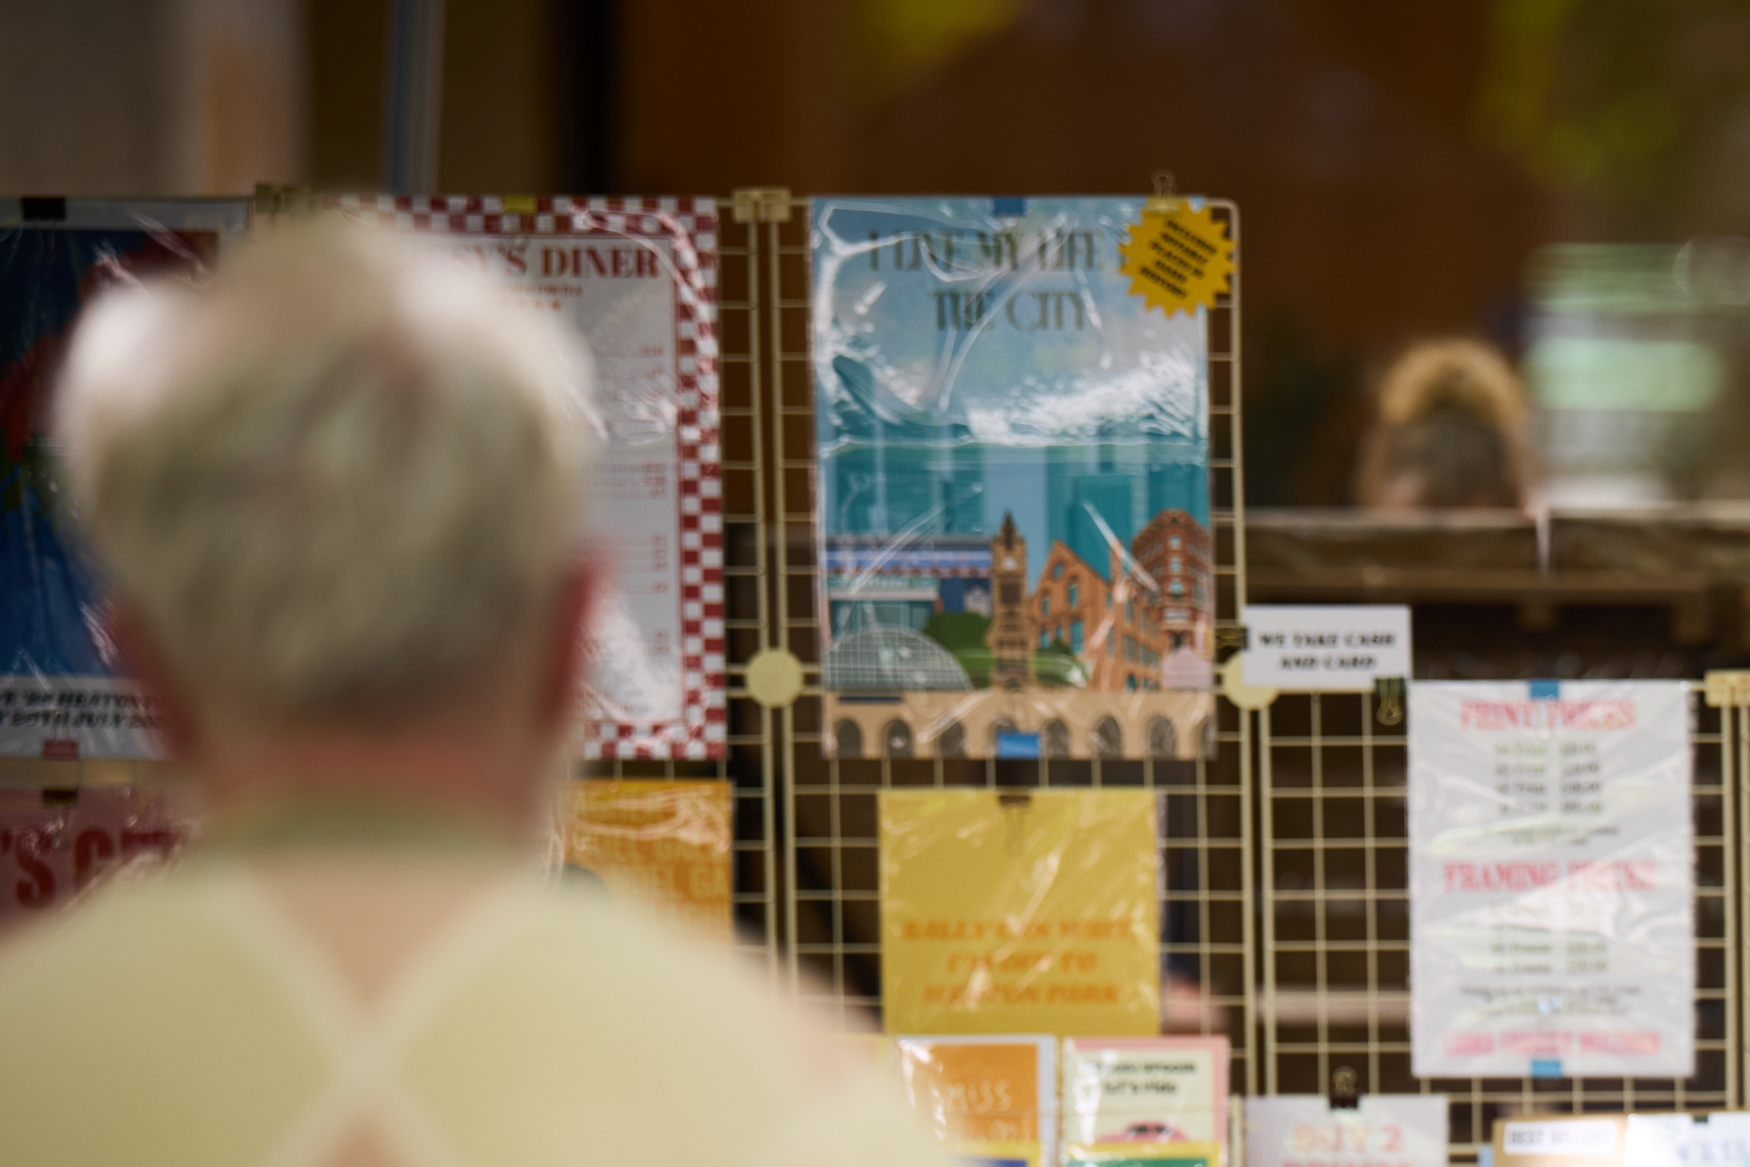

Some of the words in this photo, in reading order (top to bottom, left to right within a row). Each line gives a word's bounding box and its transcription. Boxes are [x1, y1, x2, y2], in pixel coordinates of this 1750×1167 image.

[542, 245, 659, 279] DINER
[1259, 631, 1285, 647] WE
[1293, 631, 1338, 647] TAKE
[1344, 631, 1395, 647] CASH
[1279, 654, 1318, 671] AND
[1323, 654, 1376, 671] CARD
[1460, 700, 1536, 731] PRINT
[1443, 860, 1559, 892] FRAMING
[1293, 1124, 1369, 1151] BUY
[1381, 1124, 1402, 1151] 2
